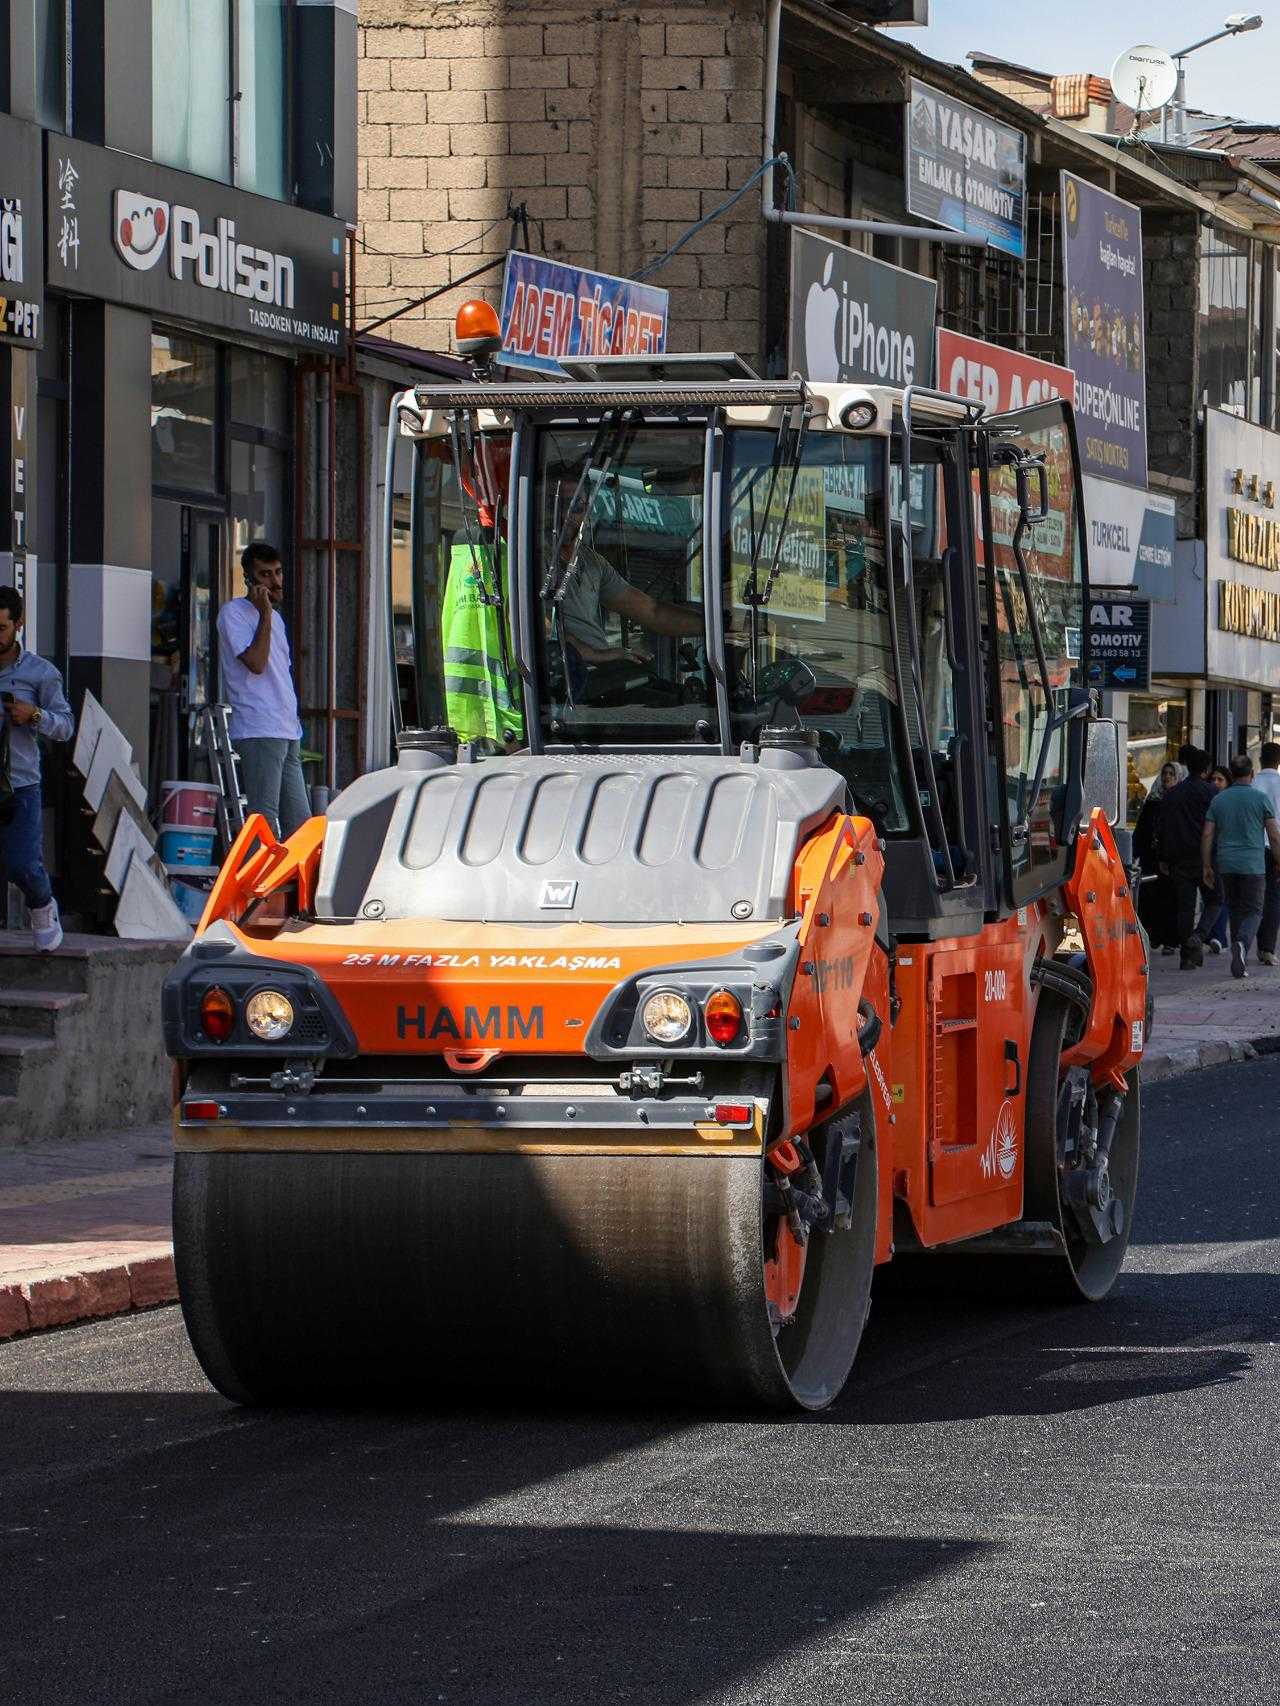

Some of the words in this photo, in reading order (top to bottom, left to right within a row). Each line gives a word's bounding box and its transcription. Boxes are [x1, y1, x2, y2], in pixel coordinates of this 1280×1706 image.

[937, 105, 998, 169] YAŞAR
[919, 159, 952, 196] EMLAK
[954, 178, 963, 199] &
[0, 198, 23, 283] Ğİ
[57, 157, 81, 272] 塗料
[170, 205, 295, 310] Polisan
[292, 320, 310, 338] YAPI
[503, 281, 574, 357] ADEM
[578, 284, 664, 356] TİCARET
[842, 281, 914, 386] iPhone
[1074, 379, 1140, 433] SUPERONLINE
[14, 405, 26, 600] VETE
[1091, 521, 1131, 553] TURKCELL
[342, 953, 374, 968] 25
[378, 954, 400, 968] M
[403, 953, 482, 969] FAZLA
[489, 953, 622, 971] YAKLAŞMA
[397, 1004, 545, 1041] HAMM
